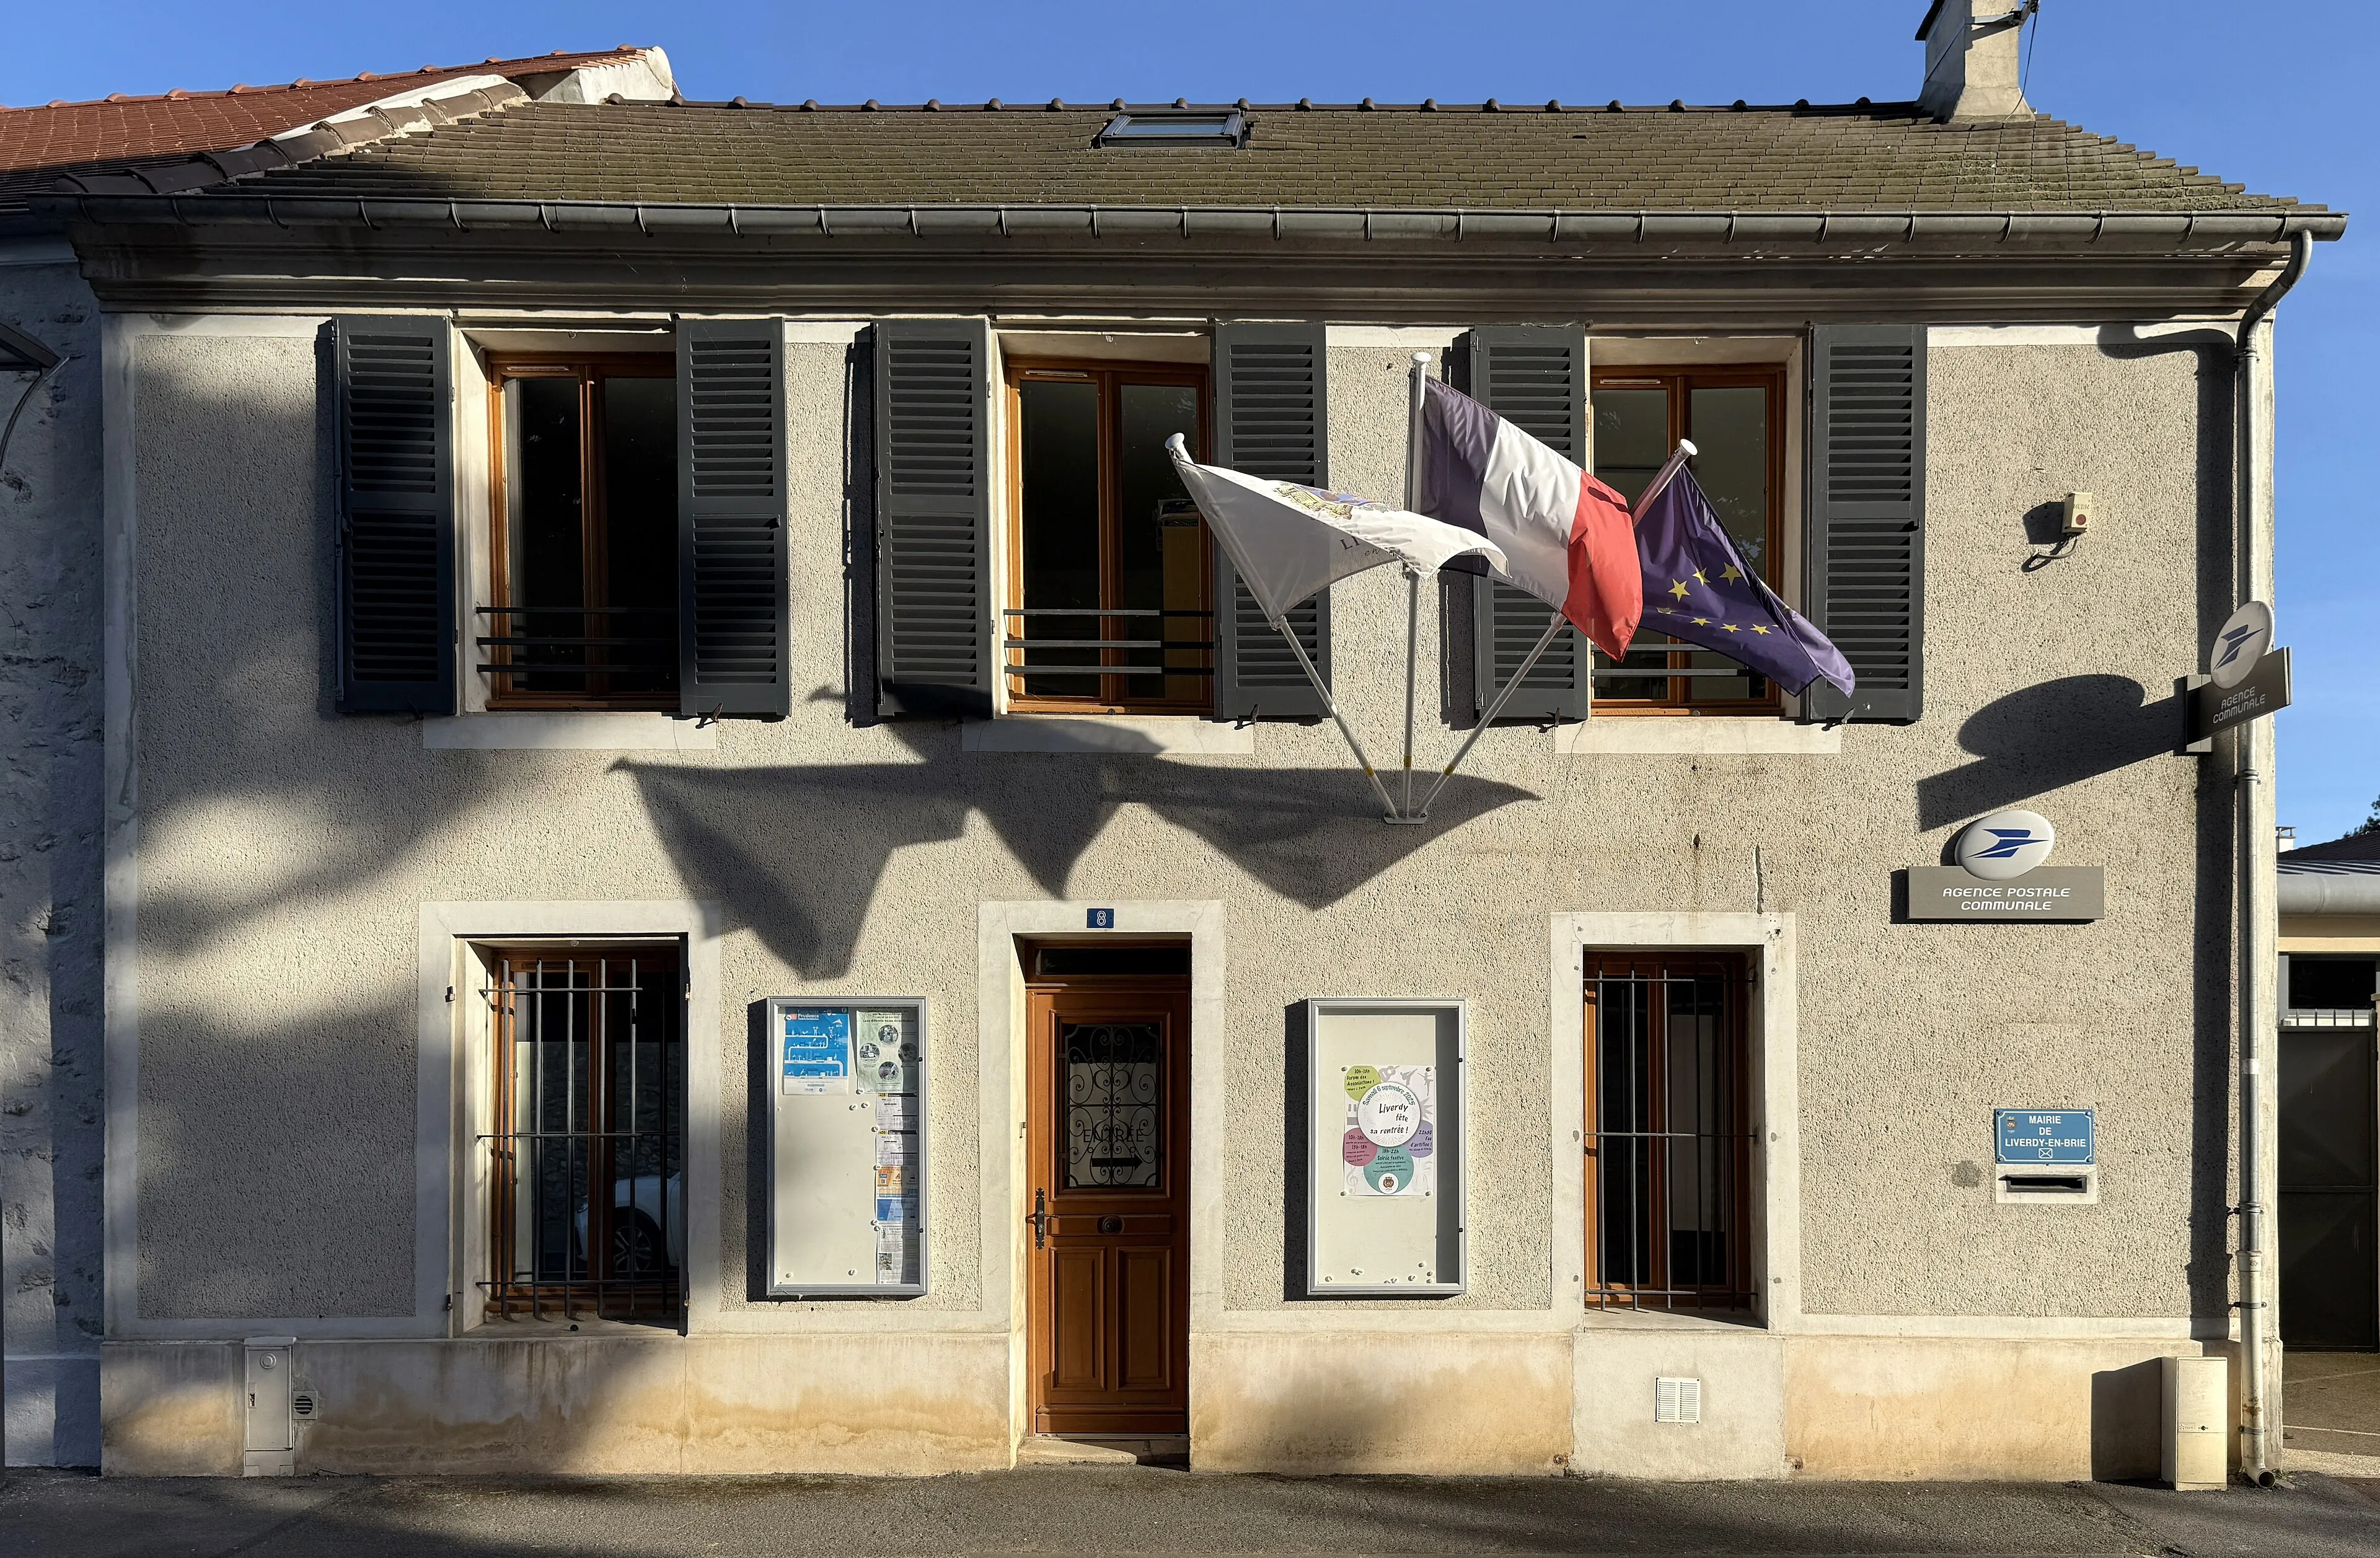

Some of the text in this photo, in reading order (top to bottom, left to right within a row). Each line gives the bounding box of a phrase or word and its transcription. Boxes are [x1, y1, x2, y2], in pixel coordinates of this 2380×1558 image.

[2221, 686, 2256, 710] AGENCE
[2213, 694, 2266, 724] COMMUNALE
[1942, 887, 2071, 897] AGENCE POSTALE
[1960, 900, 2053, 910] COMMUNALE
[1096, 910, 1106, 926] 8
[1382, 1085, 1404, 1094] septembre
[1403, 1091, 1416, 1106] 2025
[1379, 1103, 1409, 1114] Liverdy
[1396, 1113, 1408, 1122] fête
[2029, 1116, 2061, 1124] MAIRIE
[1380, 1124, 1404, 1134] rentrée
[2038, 1127, 2052, 1135] DE
[2004, 1138, 2086, 1147] LIVERDY-EN-BRIE
